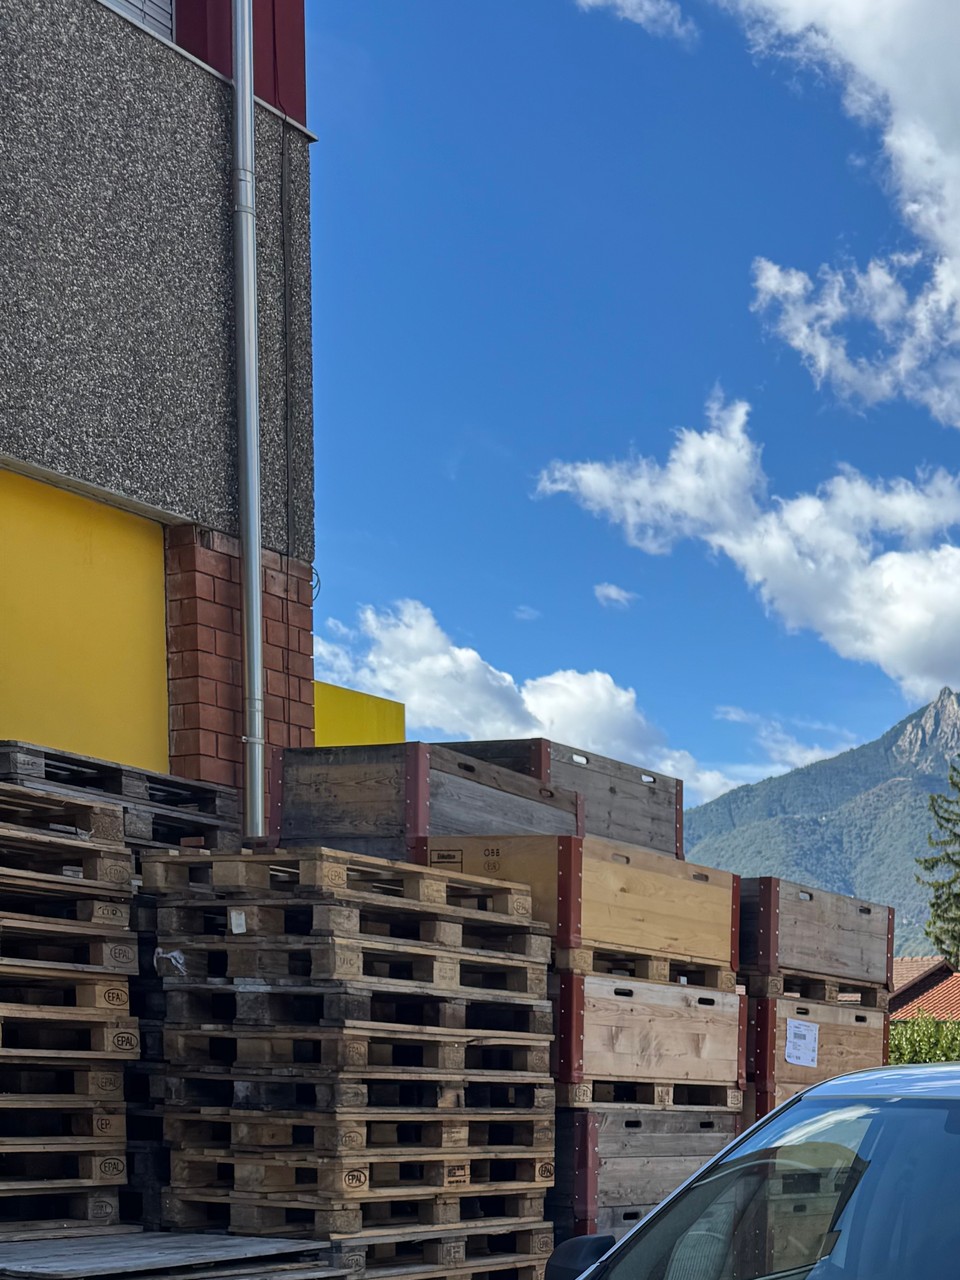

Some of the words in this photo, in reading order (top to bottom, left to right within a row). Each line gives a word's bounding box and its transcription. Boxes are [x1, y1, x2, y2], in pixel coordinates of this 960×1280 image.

[113, 948, 131, 960] EPAL
[116, 1035, 135, 1047] EPAL
[100, 1076, 117, 1088] EPAL
[104, 1161, 122, 1173] EPAL
[347, 1172, 364, 1185] EPAL
